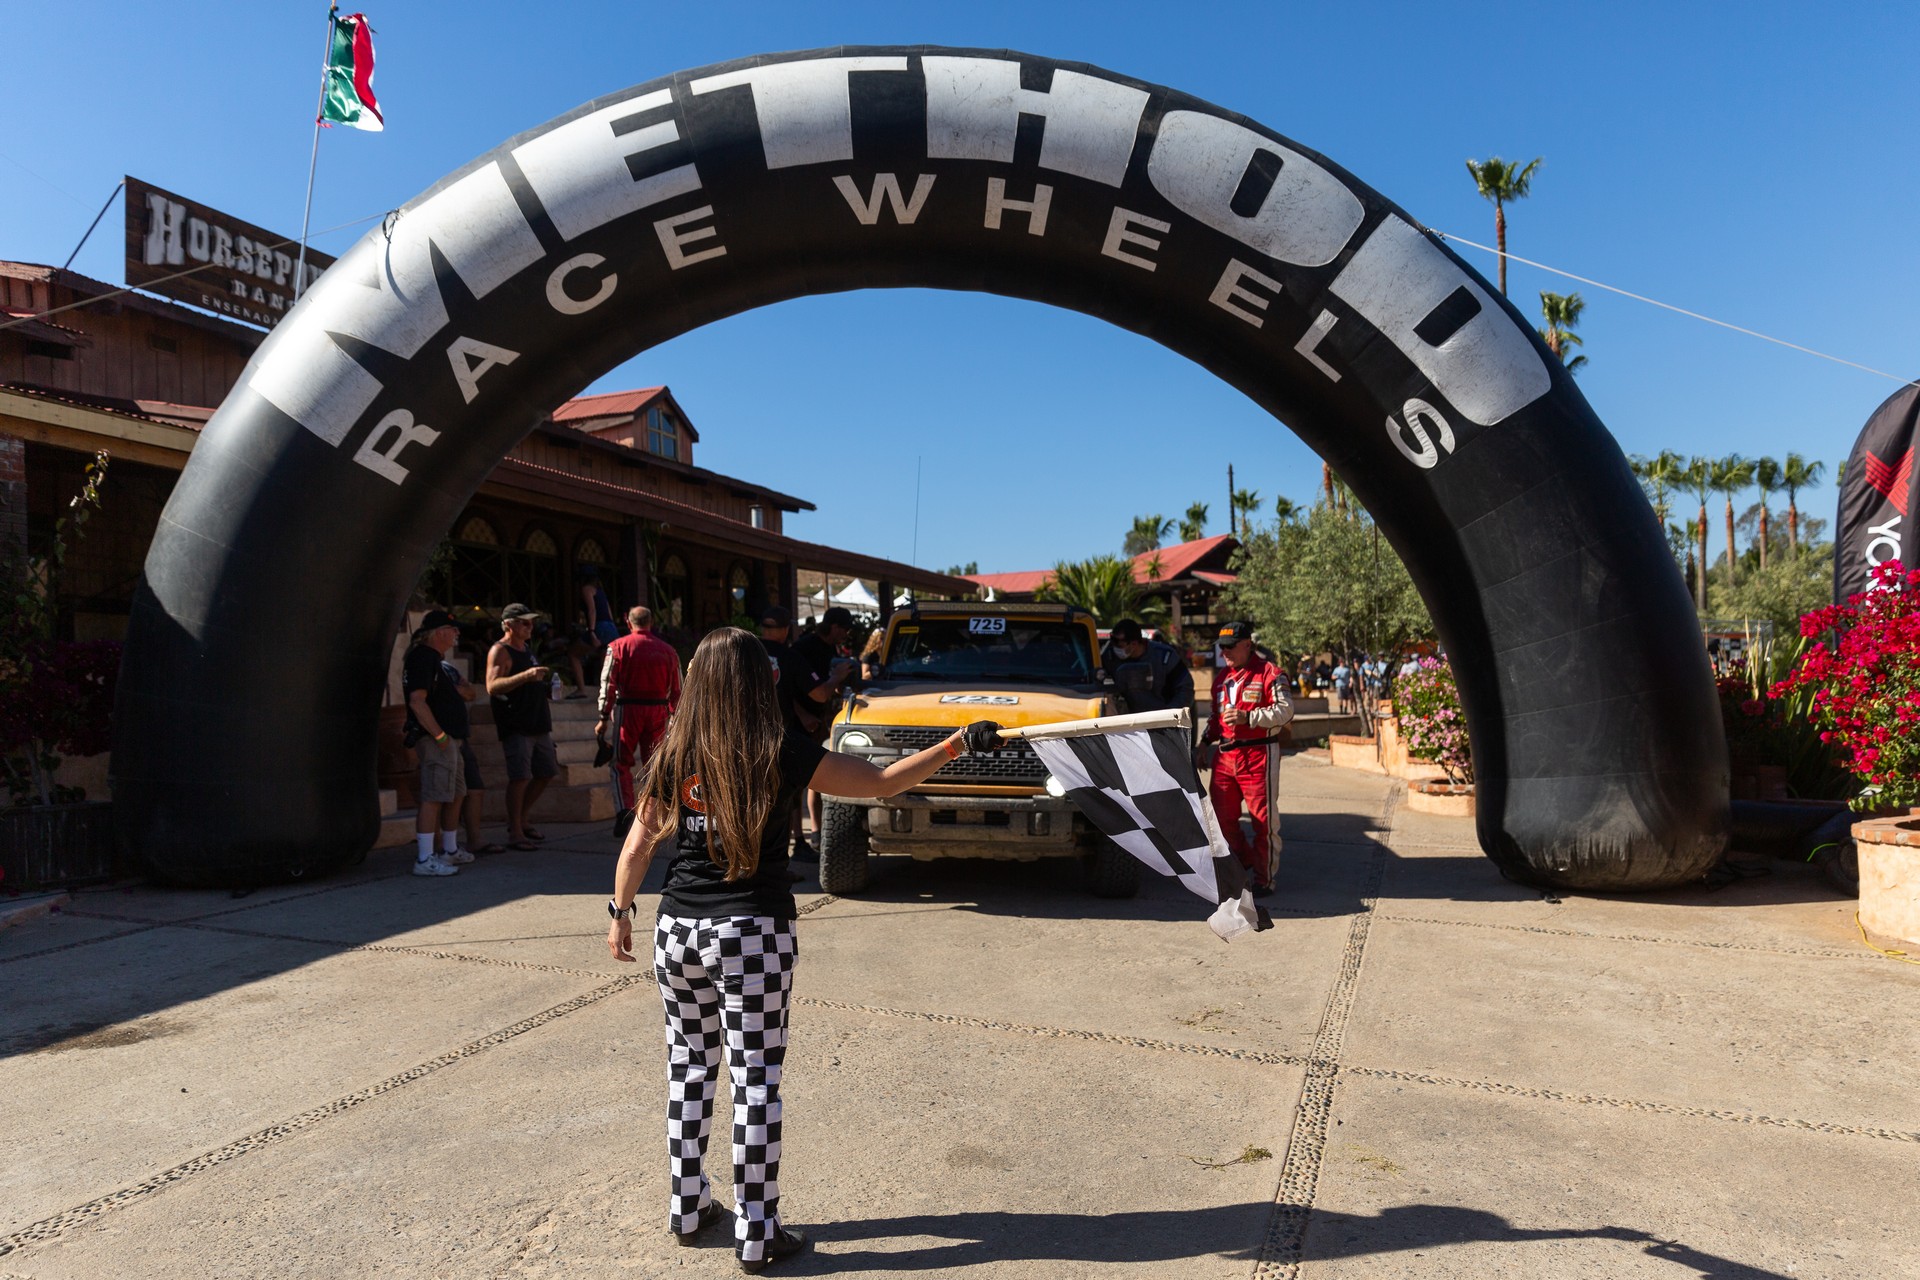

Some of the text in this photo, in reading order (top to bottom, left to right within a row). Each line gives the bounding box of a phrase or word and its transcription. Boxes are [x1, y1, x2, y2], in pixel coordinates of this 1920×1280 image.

[249, 55, 1551, 448] METHOD
[353, 173, 1455, 485] RACE WHEELS
[972, 618, 1003, 630] 725
